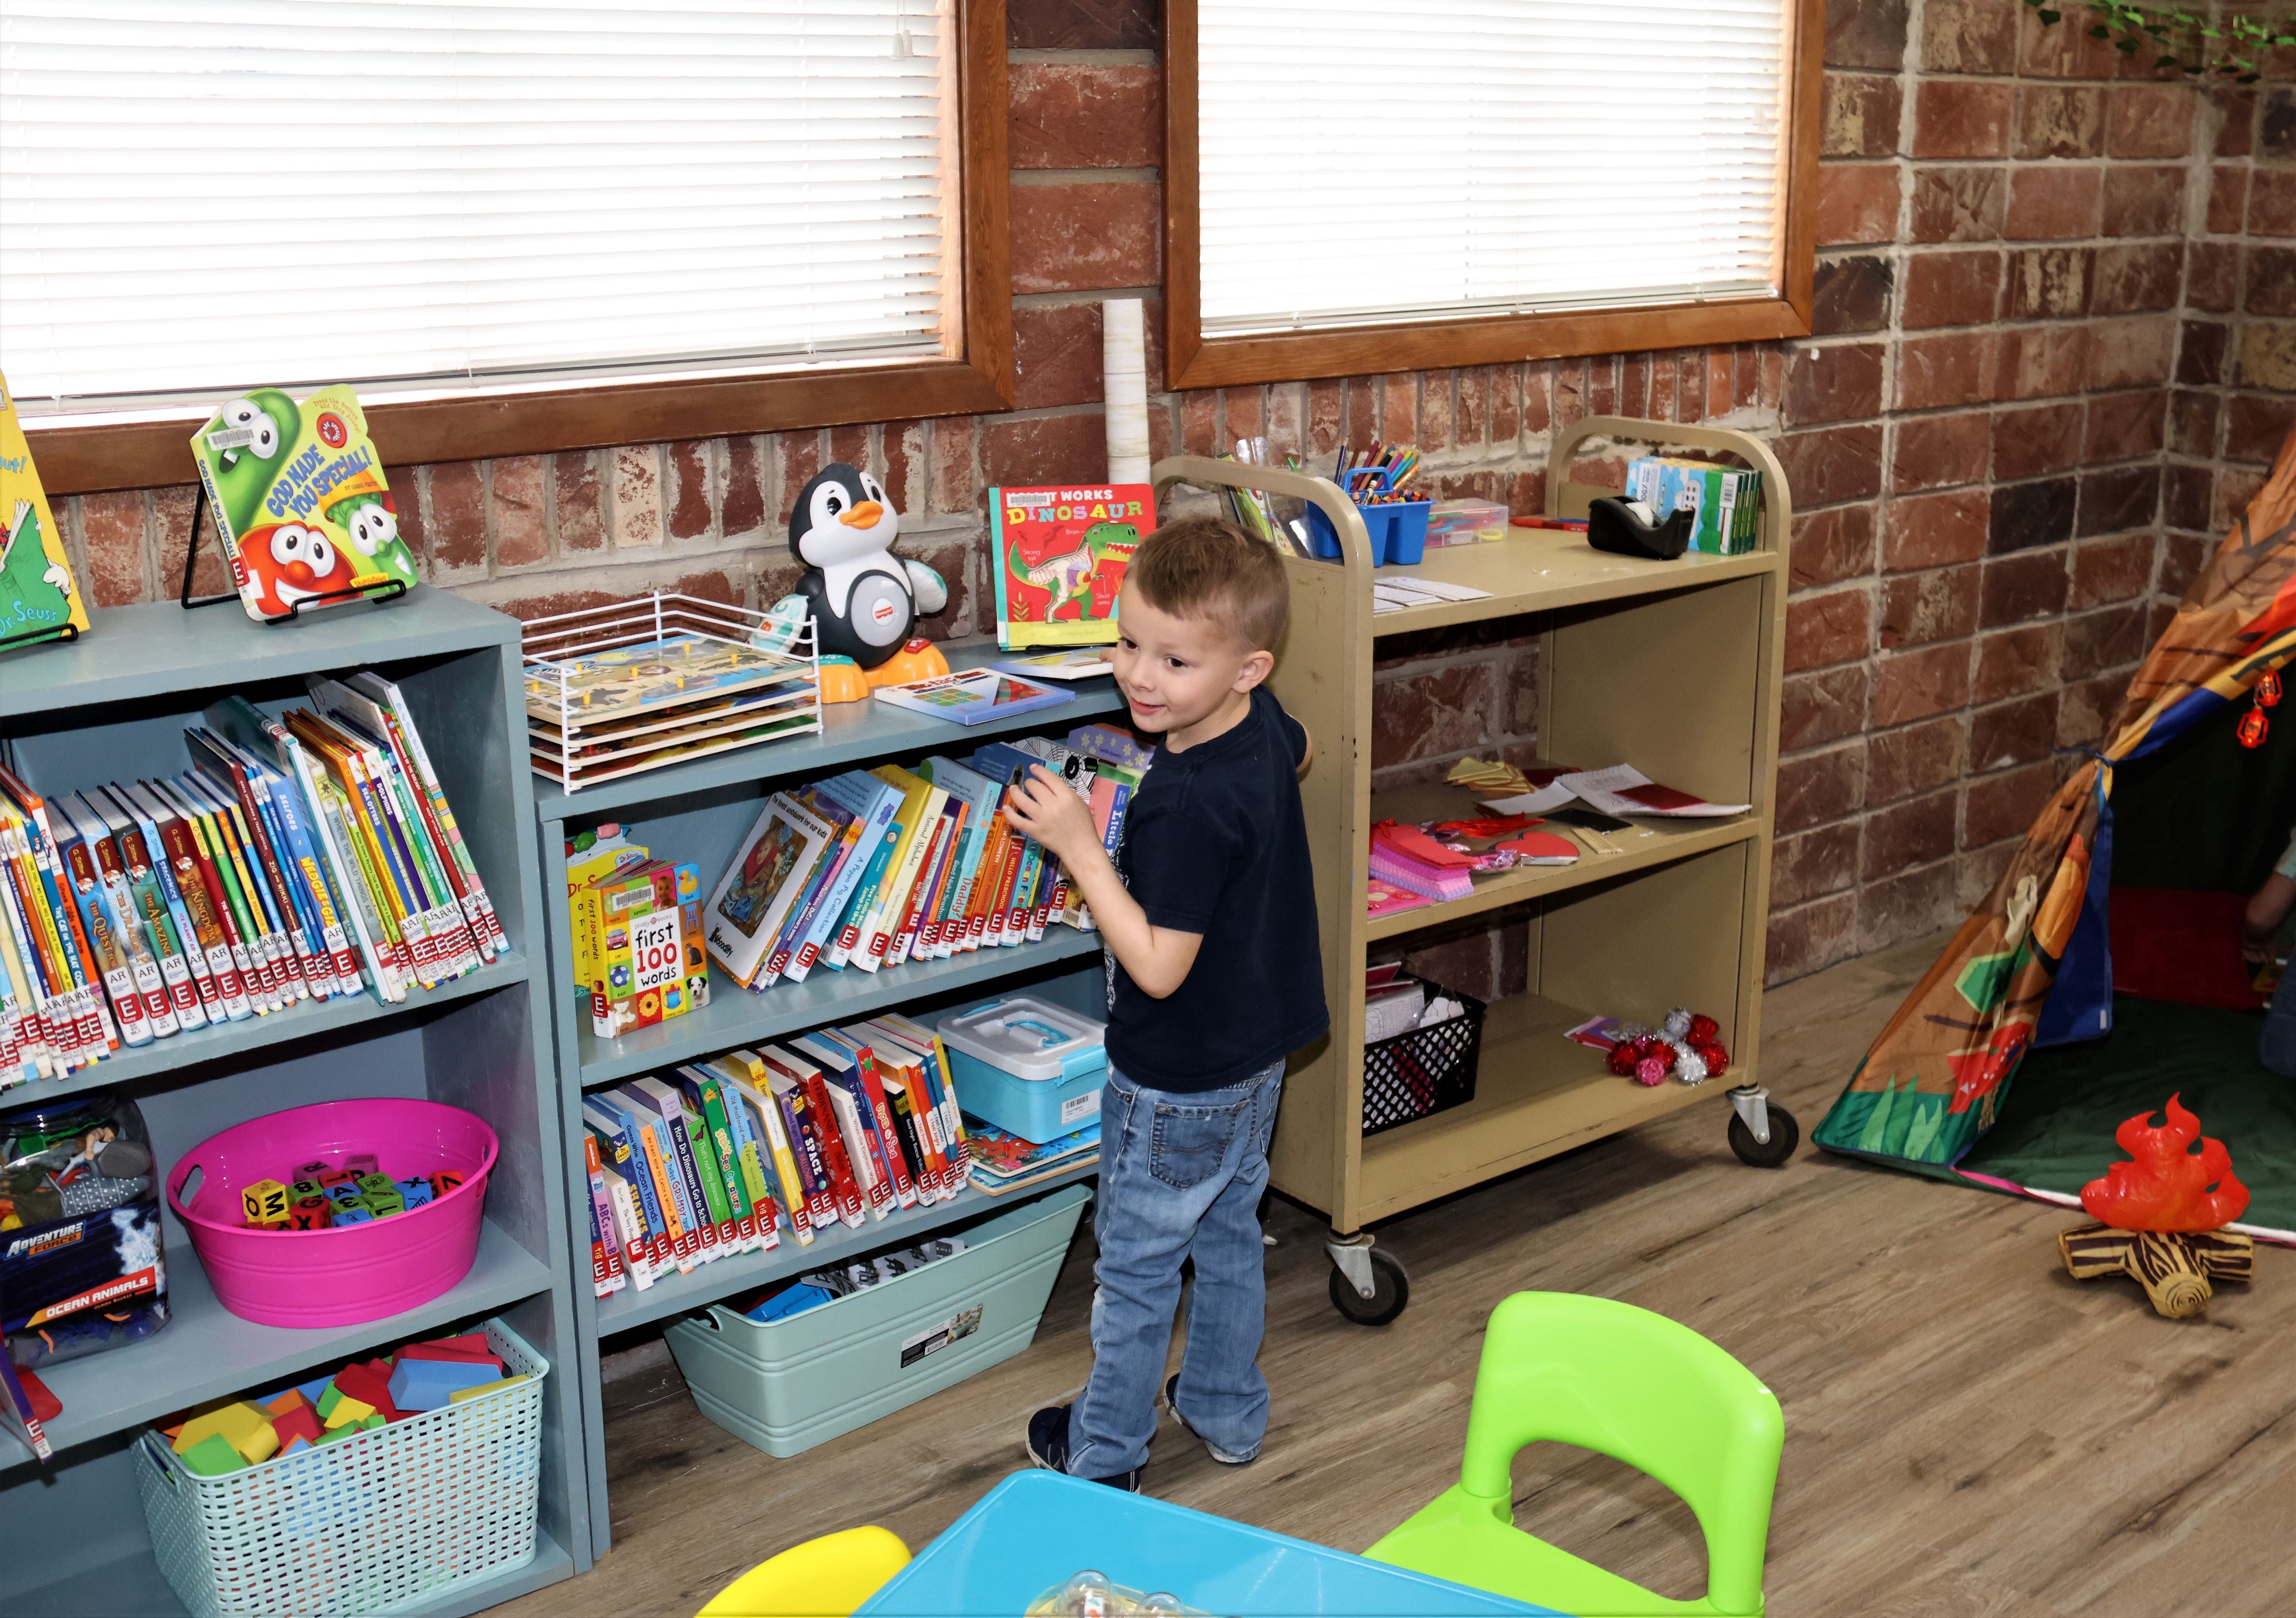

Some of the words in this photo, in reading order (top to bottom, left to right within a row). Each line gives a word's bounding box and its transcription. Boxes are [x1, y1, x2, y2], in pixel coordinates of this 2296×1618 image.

[199, 459, 208, 474] GOD
[204, 475, 216, 498] MADE
[212, 499, 222, 520] YOU
[267, 478, 294, 517] GOD
[286, 443, 325, 487] MADE
[289, 489, 318, 520] YOU
[1061, 490, 1113, 502] WORKS
[1007, 501, 1143, 525] DINOSAUR
[1022, 549, 1041, 557] Strong
[232, 562, 243, 580] E
[12, 600, 58, 624] Seuss
[376, 783, 393, 815] DOLPHINS
[279, 794, 297, 831] SELFORS
[366, 799, 381, 826] OTTERS
[803, 819, 811, 829] for
[810, 823, 819, 832] our
[817, 826, 828, 839] kids
[847, 829, 860, 841] NEW
[921, 815, 934, 840] Animal
[1107, 810, 1122, 845] Little
[333, 816, 344, 842] WHERE
[342, 843, 350, 858] THE
[348, 858, 358, 876] WILD
[354, 877, 369, 904] THINGS
[364, 904, 373, 919] ARE
[845, 864, 860, 884] Peppa
[952, 860, 960, 875] Good
[1007, 857, 1017, 876] HELLO
[1022, 854, 1034, 883] Ocean
[188, 874, 197, 890] THE
[269, 861, 277, 873] ZIG
[276, 880, 288, 904] WIKKI
[298, 856, 327, 903] WEDGIE
[116, 891, 126, 908] THE
[144, 892, 155, 908] THE
[837, 885, 848, 896] Pig
[858, 886, 870, 903] Jump
[869, 884, 877, 897] Five
[952, 877, 972, 920] Daddy?
[998, 877, 1011, 910] PRESCHOOL
[1056, 891, 1065, 905] E
[55, 907, 63, 920] THE
[89, 900, 100, 917] THE
[192, 890, 215, 942] KINGDOM
[657, 913, 672, 922] books
[818, 896, 841, 934] Collection
[1011, 911, 1023, 925] E
[58, 919, 68, 933] CAT
[119, 909, 144, 954] DRAGON
[182, 922, 192, 943] PLANET
[485, 916, 499, 930] E
[62, 932, 69, 942] IN
[93, 917, 114, 953] QUEST
[147, 908, 172, 958] AMAZING
[328, 927, 343, 939] AR
[635, 922, 673, 949] first
[841, 928, 854, 944] E
[65, 942, 74, 956] THE
[212, 948, 227, 959] AR
[636, 942, 677, 974] 100
[800, 946, 815, 962] E
[68, 955, 79, 971] HAT
[139, 966, 155, 978] AR
[166, 958, 182, 970] AR
[336, 954, 351, 971] E
[110, 971, 126, 984] AR
[221, 975, 236, 993] E
[641, 966, 677, 988] words
[149, 993, 164, 1011] E
[176, 985, 191, 1003] E
[120, 999, 137, 1017] E
[594, 996, 604, 1012] E
[753, 1072, 766, 1082] NEW
[814, 1081, 833, 1133] FERDINAND
[733, 1105, 743, 1133] MacDonald
[674, 1125, 682, 1143] How
[875, 1102, 889, 1130] UNDER
[886, 1136, 898, 1159] Sea
[678, 1142, 686, 1153] Do
[805, 1137, 822, 1176] SPACE
[720, 1153, 730, 1172] Sea
[861, 1144, 871, 1172] Elephant
[626, 1124, 634, 1143] Guess
[636, 1161, 648, 1191] Ocean
[645, 1191, 658, 1224] Friends
[682, 1153, 696, 1189] Dinosaurs
[667, 1163, 676, 1182] THREE
[672, 1181, 687, 1216] GRUMPY
[692, 1188, 699, 1198] Go
[725, 1170, 742, 1214] Creatures
[629, 1184, 649, 1234] SHARKS
[695, 1198, 701, 1208] to
[758, 1202, 766, 1216] tig
[598, 1203, 609, 1228] ABCs
[759, 1215, 770, 1231] E
[6, 1222, 84, 1257] ADVENTURE
[34, 1233, 77, 1253] FORCE
[603, 1228, 613, 1247] with
[702, 1228, 713, 1243] E
[607, 1247, 617, 1256] B
[45, 1296, 90, 1318] OCEAN
[92, 1276, 148, 1302] ANIMALS
